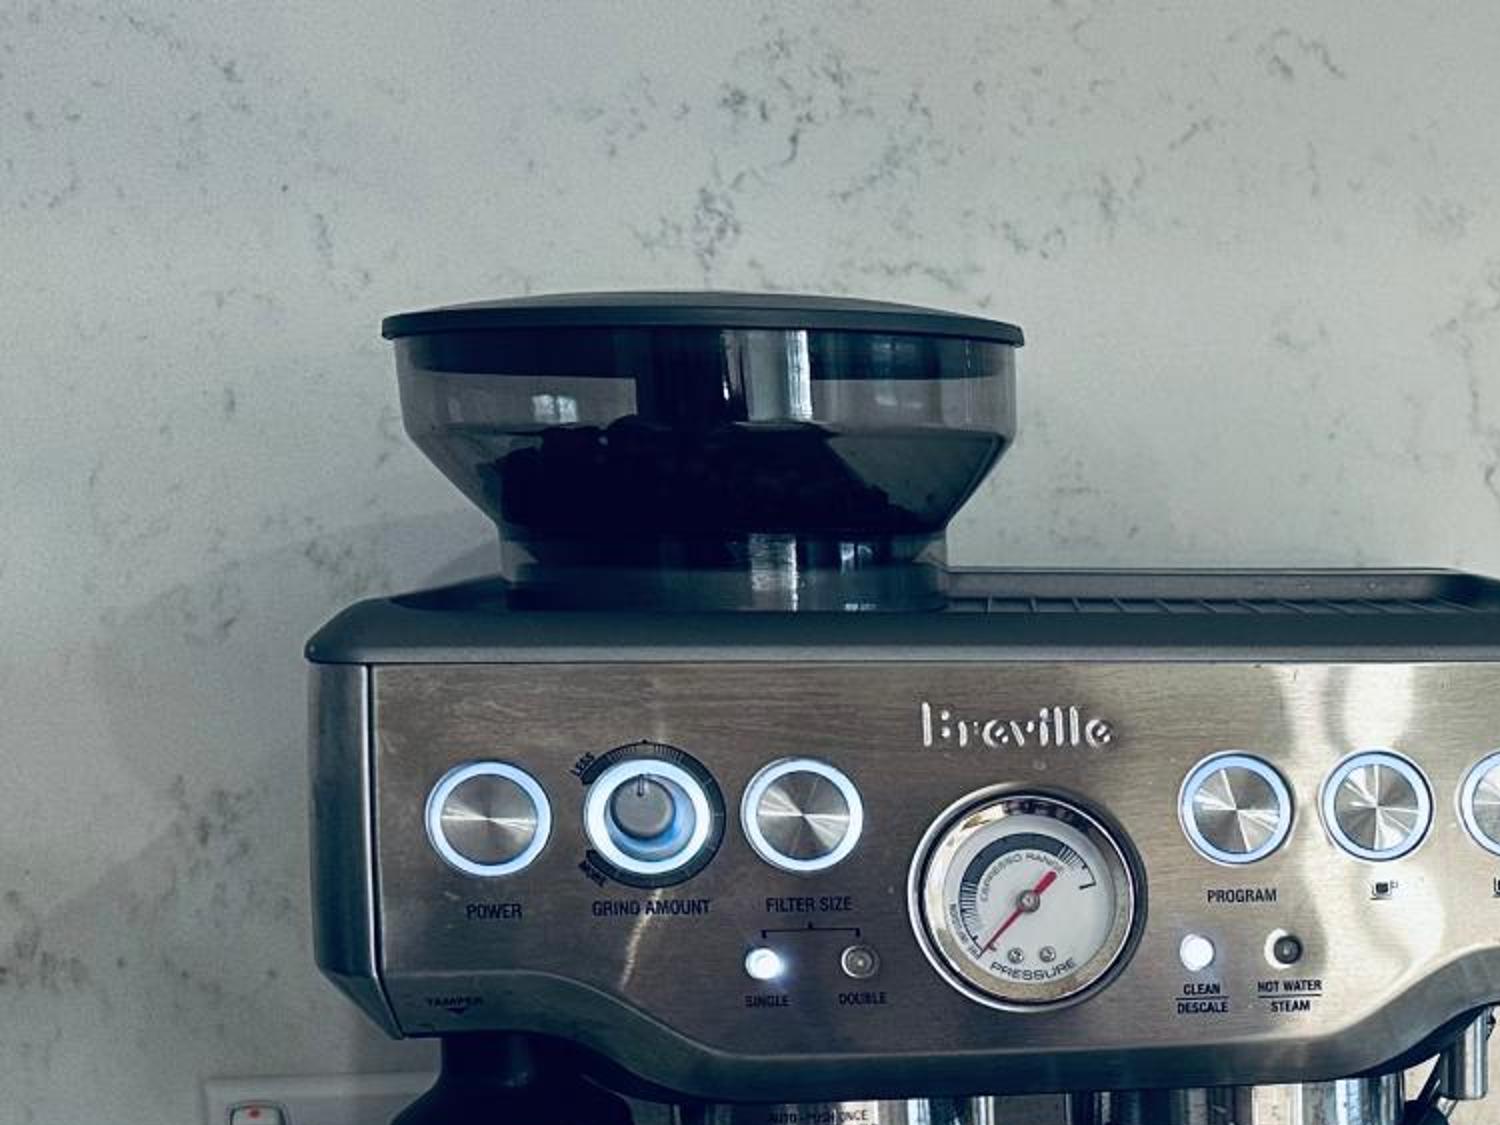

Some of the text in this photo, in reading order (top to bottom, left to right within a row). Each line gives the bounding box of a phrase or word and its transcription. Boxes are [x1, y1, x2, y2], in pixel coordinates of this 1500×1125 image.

[921, 701, 1112, 747] Breville
[1207, 888, 1277, 903] PROGRAM
[466, 903, 523, 919] POWER
[592, 899, 710, 916] GRIND AMOUNT
[765, 896, 853, 913] FILTER SIZE
[990, 958, 1076, 981] PRESSURE
[1183, 983, 1221, 995] CLEAN
[1257, 979, 1323, 992] HOT WATER
[745, 994, 791, 1007] SINGLE
[838, 991, 888, 1005] DOUBLE
[1177, 1001, 1229, 1014] DESCALE
[1270, 1000, 1311, 1012] STEAM
